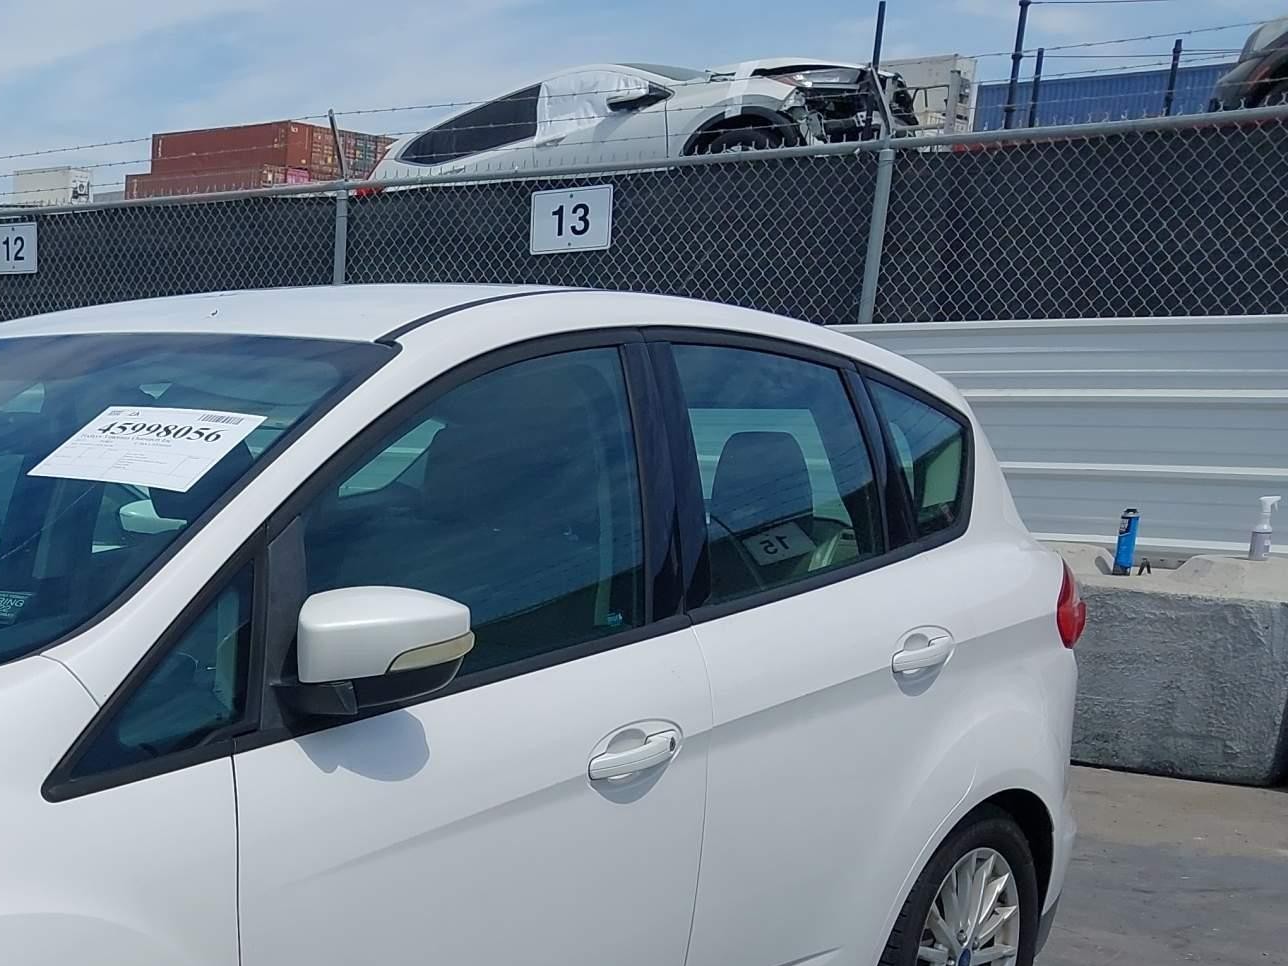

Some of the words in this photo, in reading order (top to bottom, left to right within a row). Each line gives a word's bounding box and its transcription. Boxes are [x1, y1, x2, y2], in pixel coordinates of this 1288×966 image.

[551, 203, 590, 237] 13
[2, 235, 25, 262] 12
[97, 421, 227, 443] 45998056
